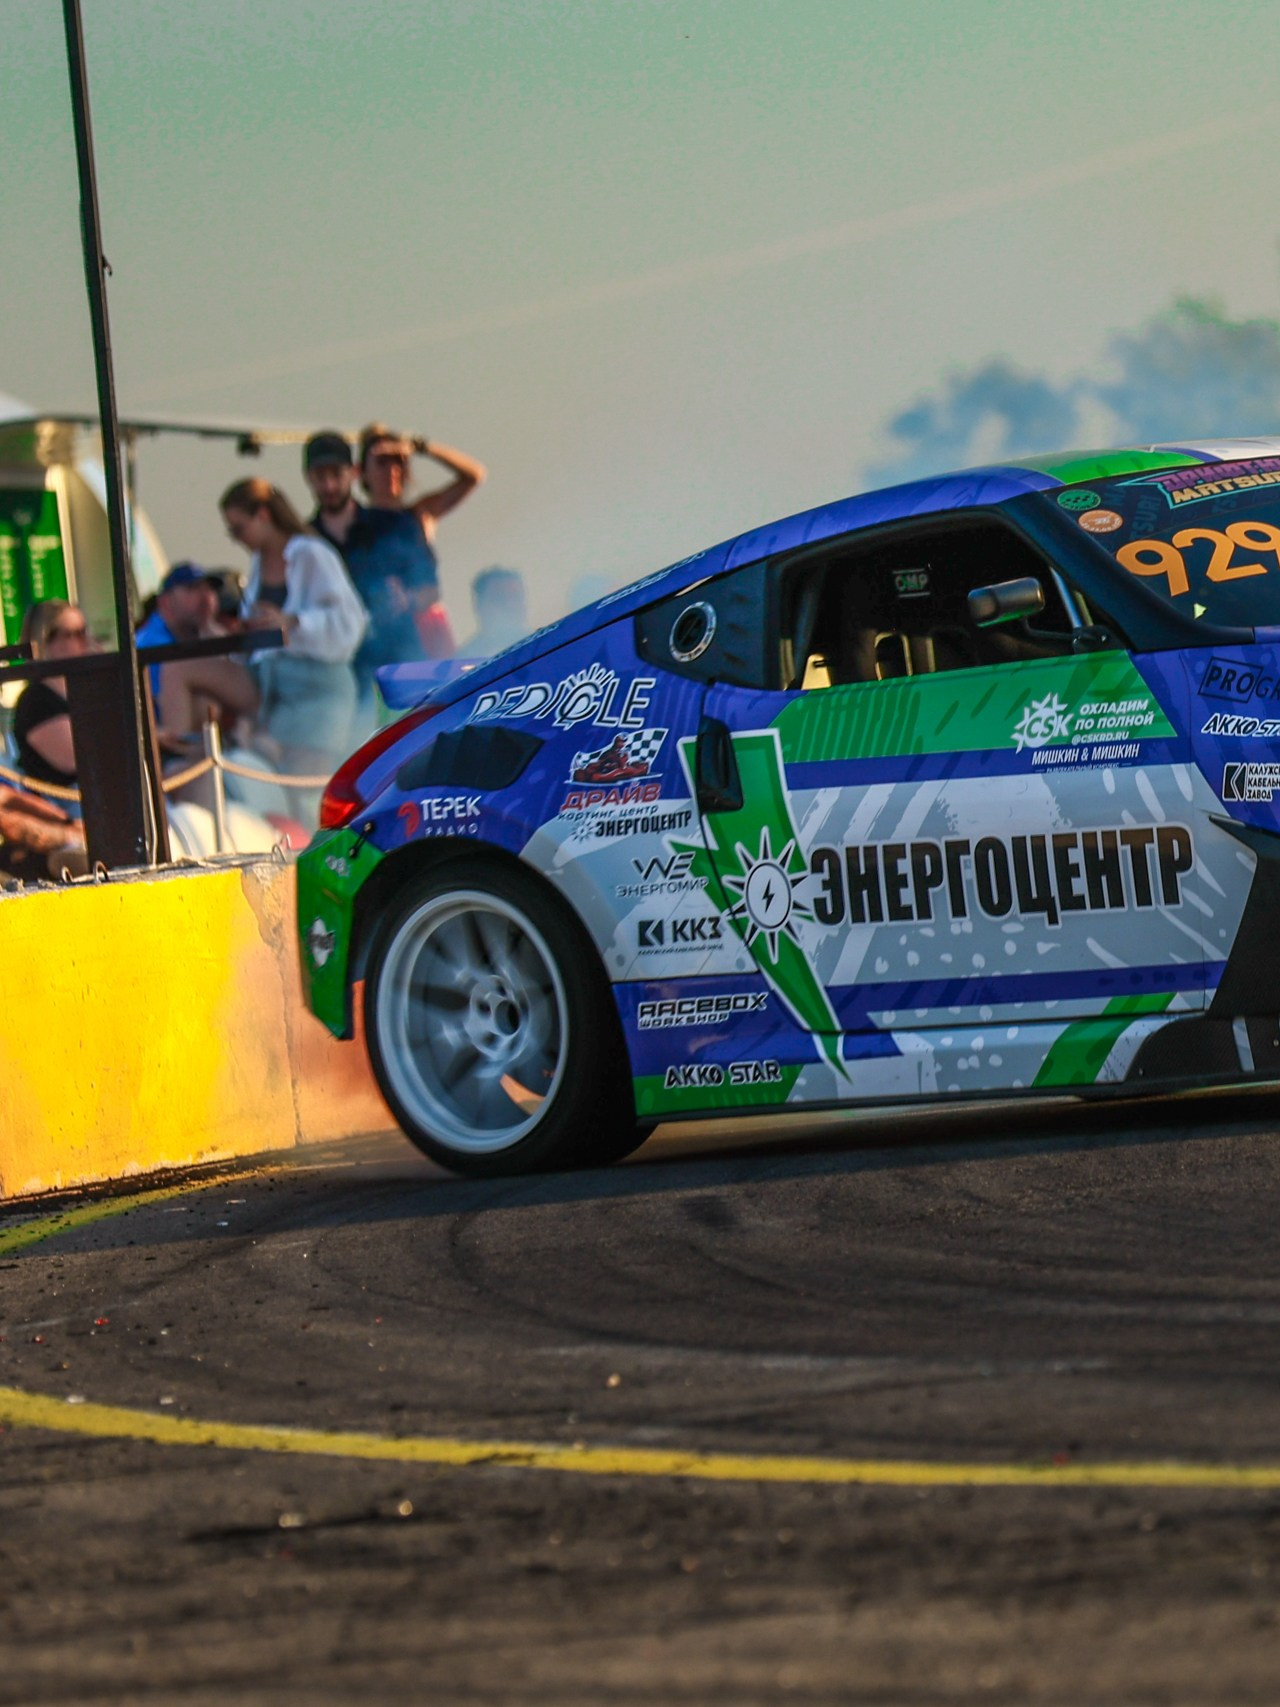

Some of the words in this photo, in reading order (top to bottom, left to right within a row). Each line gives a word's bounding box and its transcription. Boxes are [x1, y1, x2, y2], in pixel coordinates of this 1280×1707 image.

[895, 574, 928, 591] OMP
[1080, 699, 1149, 716] ОХЛАДИМ
[1026, 713, 1074, 739] CSK
[1075, 718, 1094, 731] ПО
[1097, 711, 1155, 729] ПОЛНОЙ
[1032, 748, 1078, 766] МИШКИН
[1081, 748, 1089, 762] &
[1092, 743, 1140, 761] МИШКИН
[560, 781, 661, 812] ДРАЙВ
[1246, 788, 1272, 800] ЗАВОД
[420, 796, 481, 821] ТЕРЕК
[619, 805, 659, 818] центр
[425, 823, 479, 837] РАДИО
[595, 810, 692, 838] ЭНЕРГОЦЕНТР
[616, 876, 709, 898] ЭНЕРГОМИР
[810, 826, 1193, 925] ЭНЕРГОЦЕНТР
[672, 916, 723, 943] ККЗ
[638, 992, 768, 1018] RACEBOX
[638, 1012, 730, 1030] WORKSHOP
[664, 1064, 724, 1088] AKKO
[728, 1060, 782, 1085] STAR
